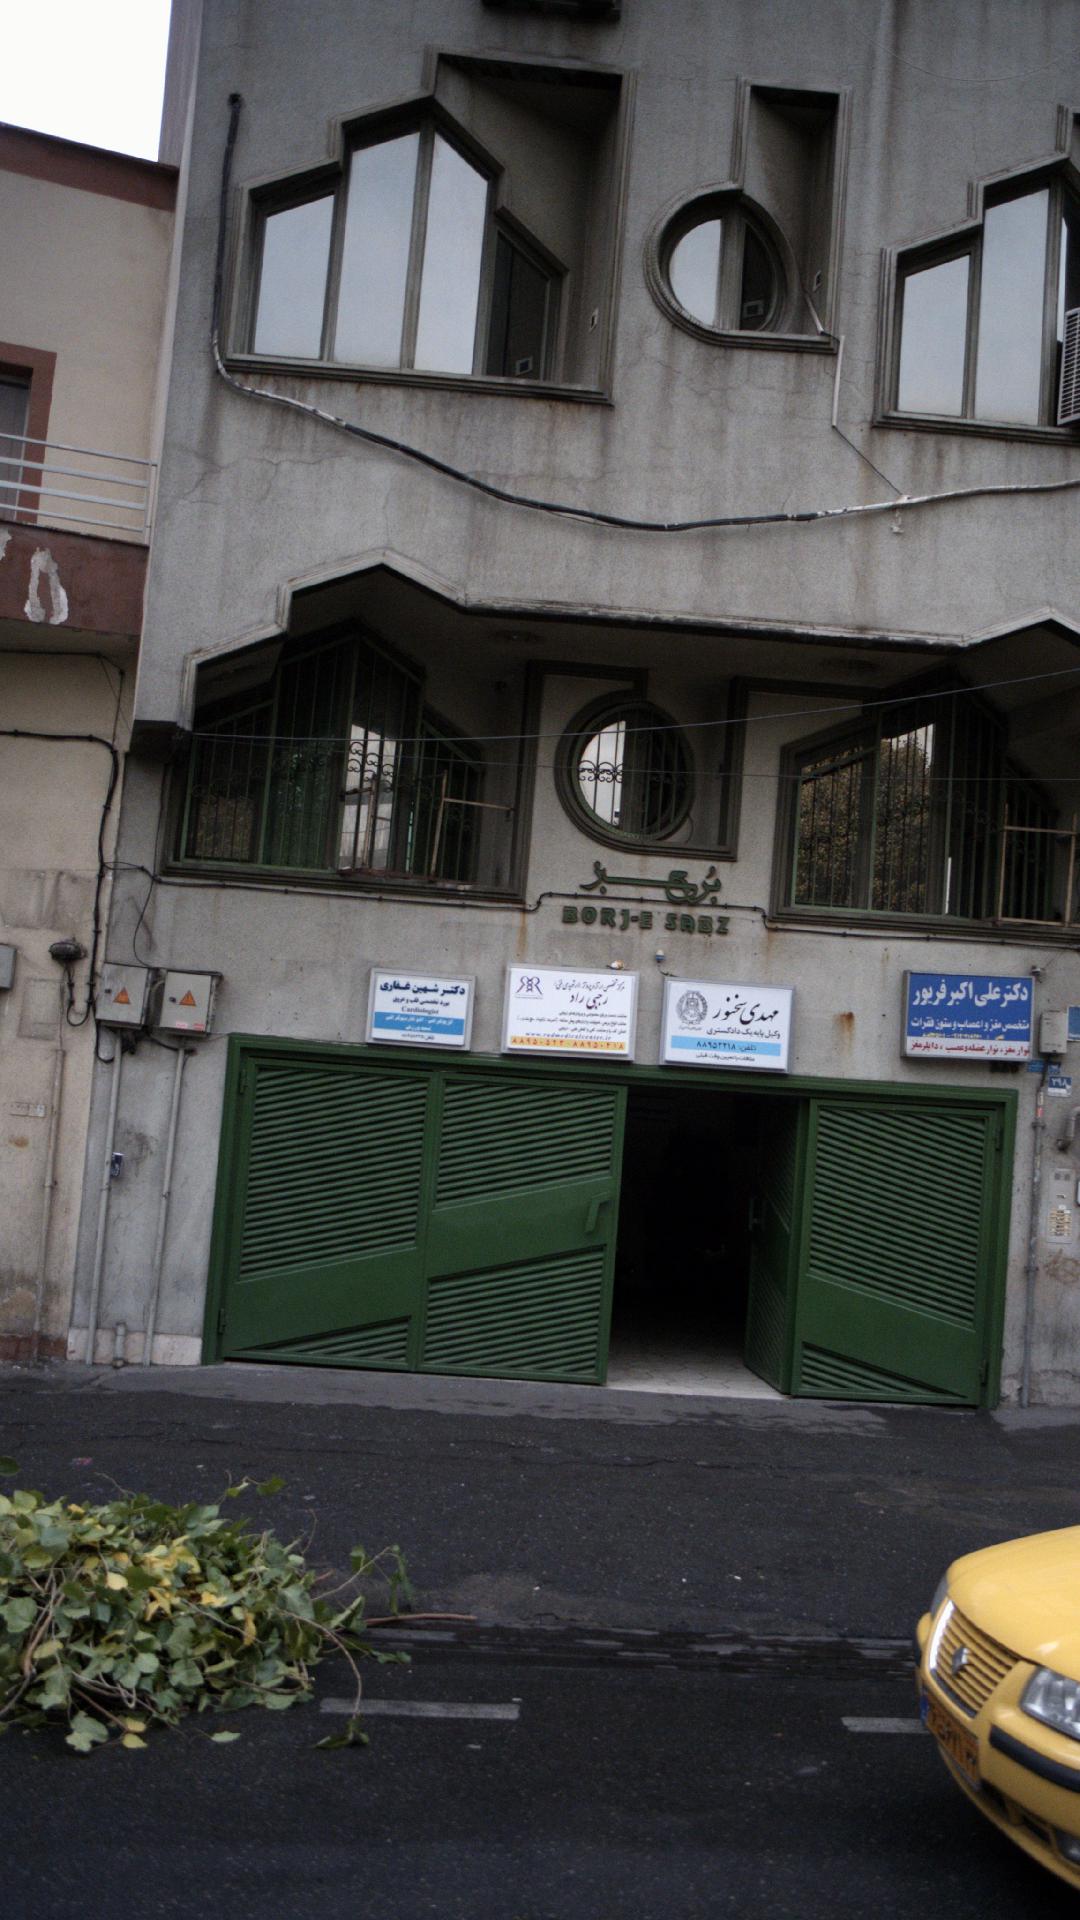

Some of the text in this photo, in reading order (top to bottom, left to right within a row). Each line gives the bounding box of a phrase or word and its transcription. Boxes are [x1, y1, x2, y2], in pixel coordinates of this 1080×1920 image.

[562, 906, 731, 936] BORJ-E SABZ
[380, 980, 466, 997] دکتر شهین غفاری
[947, 981, 974, 1006] اکبر
[975, 982, 1001, 1007] علی
[1000, 982, 1029, 1008] دکتر
[569, 992, 585, 1003] راد
[712, 993, 779, 1025] مهدی سخنور
[911, 1016, 935, 1030] فقرات
[935, 1017, 952, 1030] ستون
[957, 1018, 983, 1031] اعصاب
[989, 1018, 1002, 1032] مغز
[1002, 1018, 1030, 1033] متخصص
[706, 1026, 741, 1036] دادگستری
[741, 1027, 754, 1036] یک
[753, 1028, 764, 1038] پایه
[764, 1030, 781, 1039] وکیل
